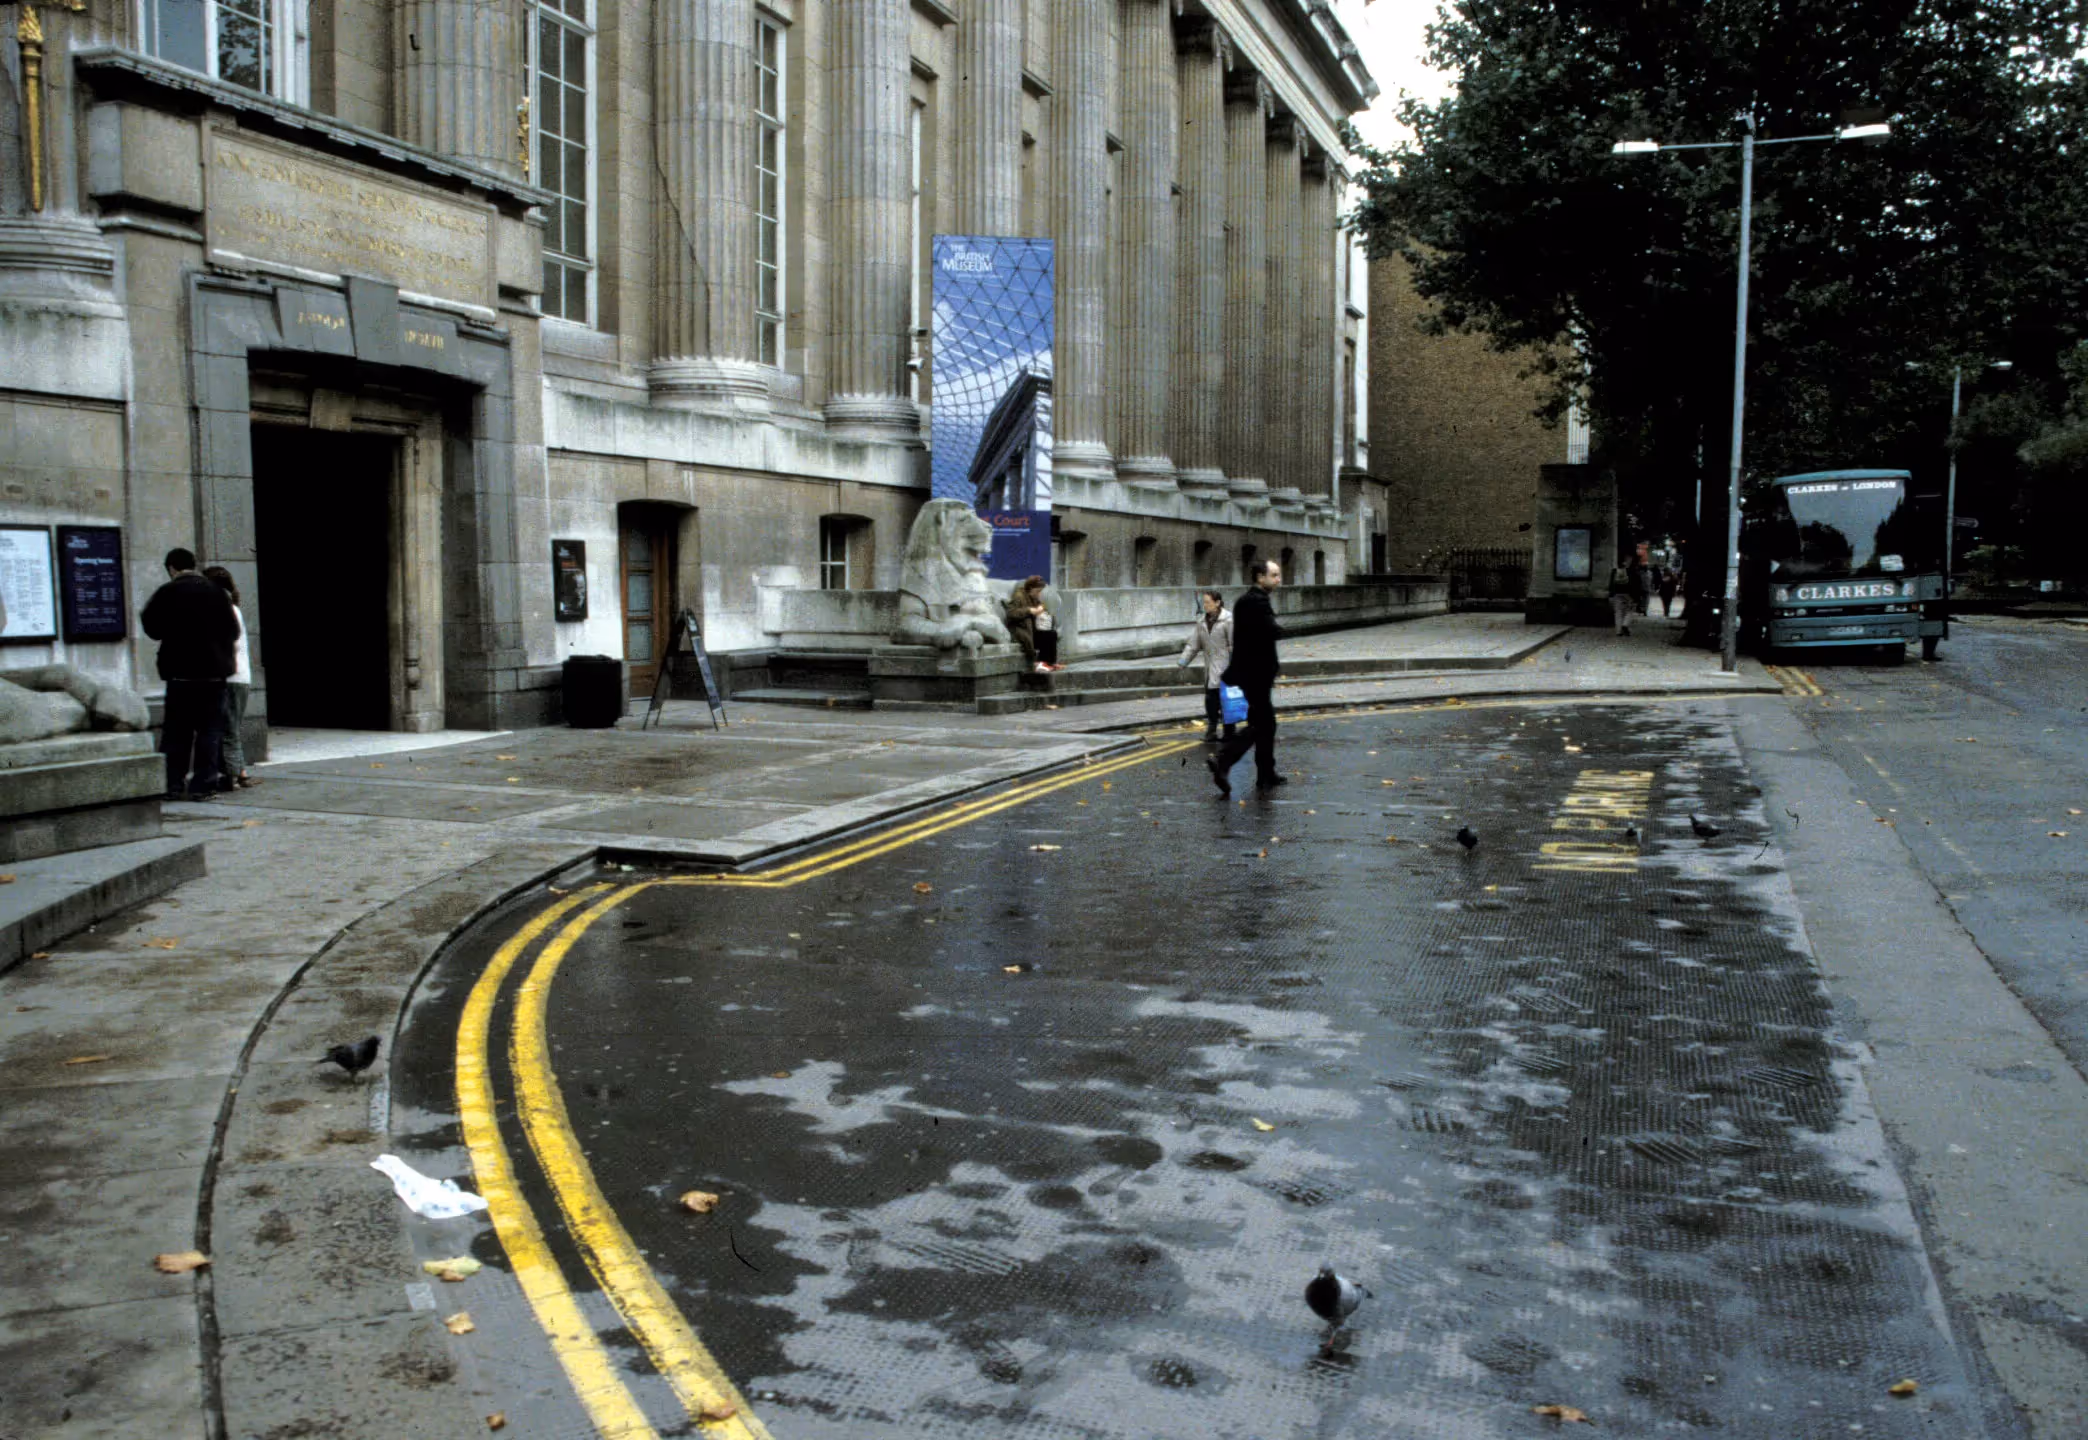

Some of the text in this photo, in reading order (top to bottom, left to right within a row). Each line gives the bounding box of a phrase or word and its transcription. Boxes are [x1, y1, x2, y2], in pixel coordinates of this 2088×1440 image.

[950, 244, 964, 252] THE
[954, 252, 990, 260] BRITISH
[942, 258, 993, 272] MUSEUM
[1787, 484, 1838, 494] CLARKES
[1853, 481, 1896, 490] LONDON
[994, 514, 1031, 527] Court
[1797, 584, 1895, 600] CLARKES
[1530, 842, 1640, 872] NO
